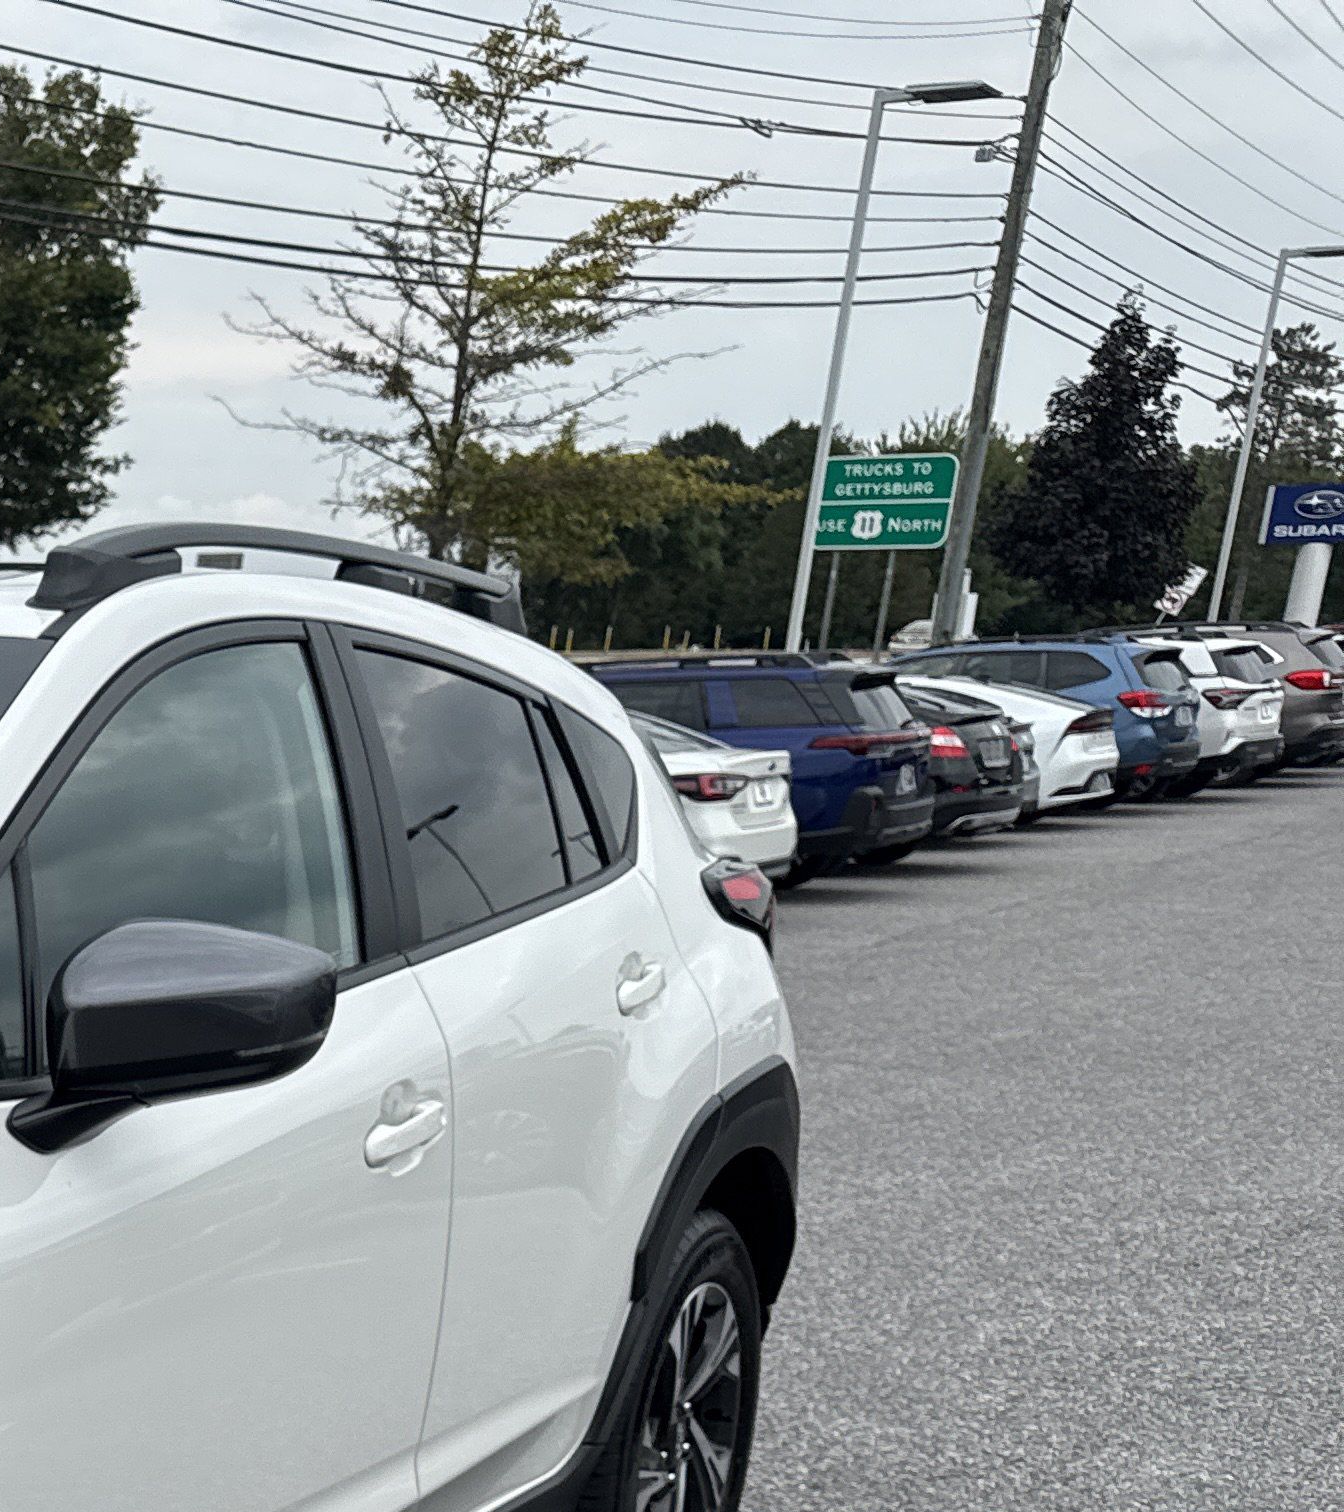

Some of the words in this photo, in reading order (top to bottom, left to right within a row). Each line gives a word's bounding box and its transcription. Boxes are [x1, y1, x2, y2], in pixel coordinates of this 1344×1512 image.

[844, 462, 904, 477] TRUCKS
[912, 462, 932, 475] TO
[834, 481, 934, 497] GETTYSBURG
[818, 519, 846, 533] USE
[860, 515, 875, 534] 11
